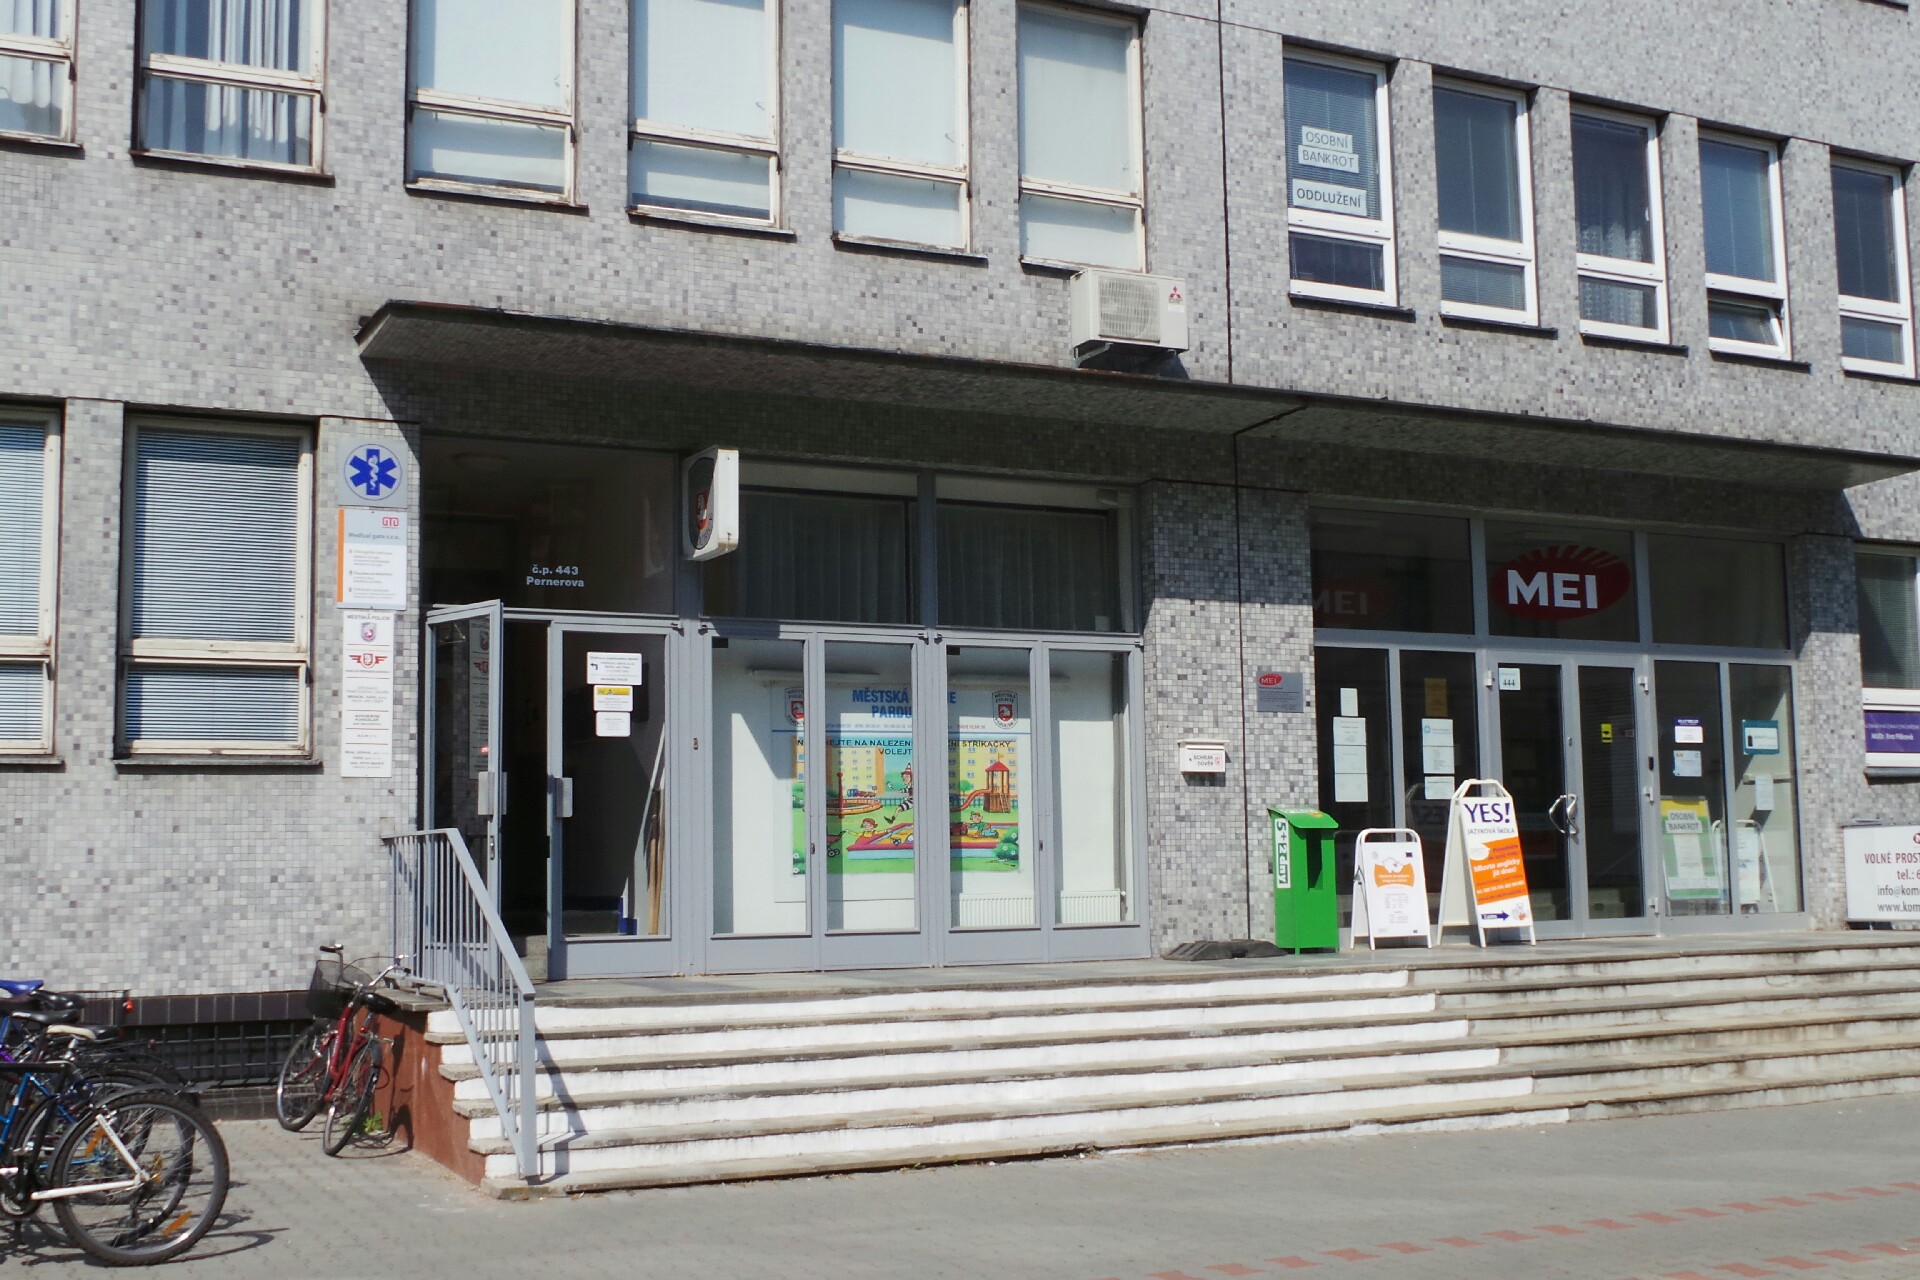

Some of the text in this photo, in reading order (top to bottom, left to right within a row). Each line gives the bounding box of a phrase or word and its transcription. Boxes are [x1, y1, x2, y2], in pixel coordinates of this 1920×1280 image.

[1306, 131, 1348, 148] OSOBNÍ
[1302, 150, 1355, 168] BANKROT
[1296, 187, 1362, 208] ODDLUŽENÍ
[532, 564, 579, 576] č.p. 443
[526, 575, 585, 588] Pernerova
[1507, 569, 1598, 609] MEI
[852, 688, 910, 703] MĚSTSKÁ
[871, 705, 912, 719] PARDU
[854, 739, 868, 747] NA
[869, 739, 912, 747] NALEZEN
[878, 748, 912, 756] VOLEJT
[1463, 802, 1510, 824] YES!
[1496, 826, 1515, 834] ŠKOLA
[1864, 851, 1892, 865] VOLNÉ
[1876, 884, 1920, 898] info@kom
